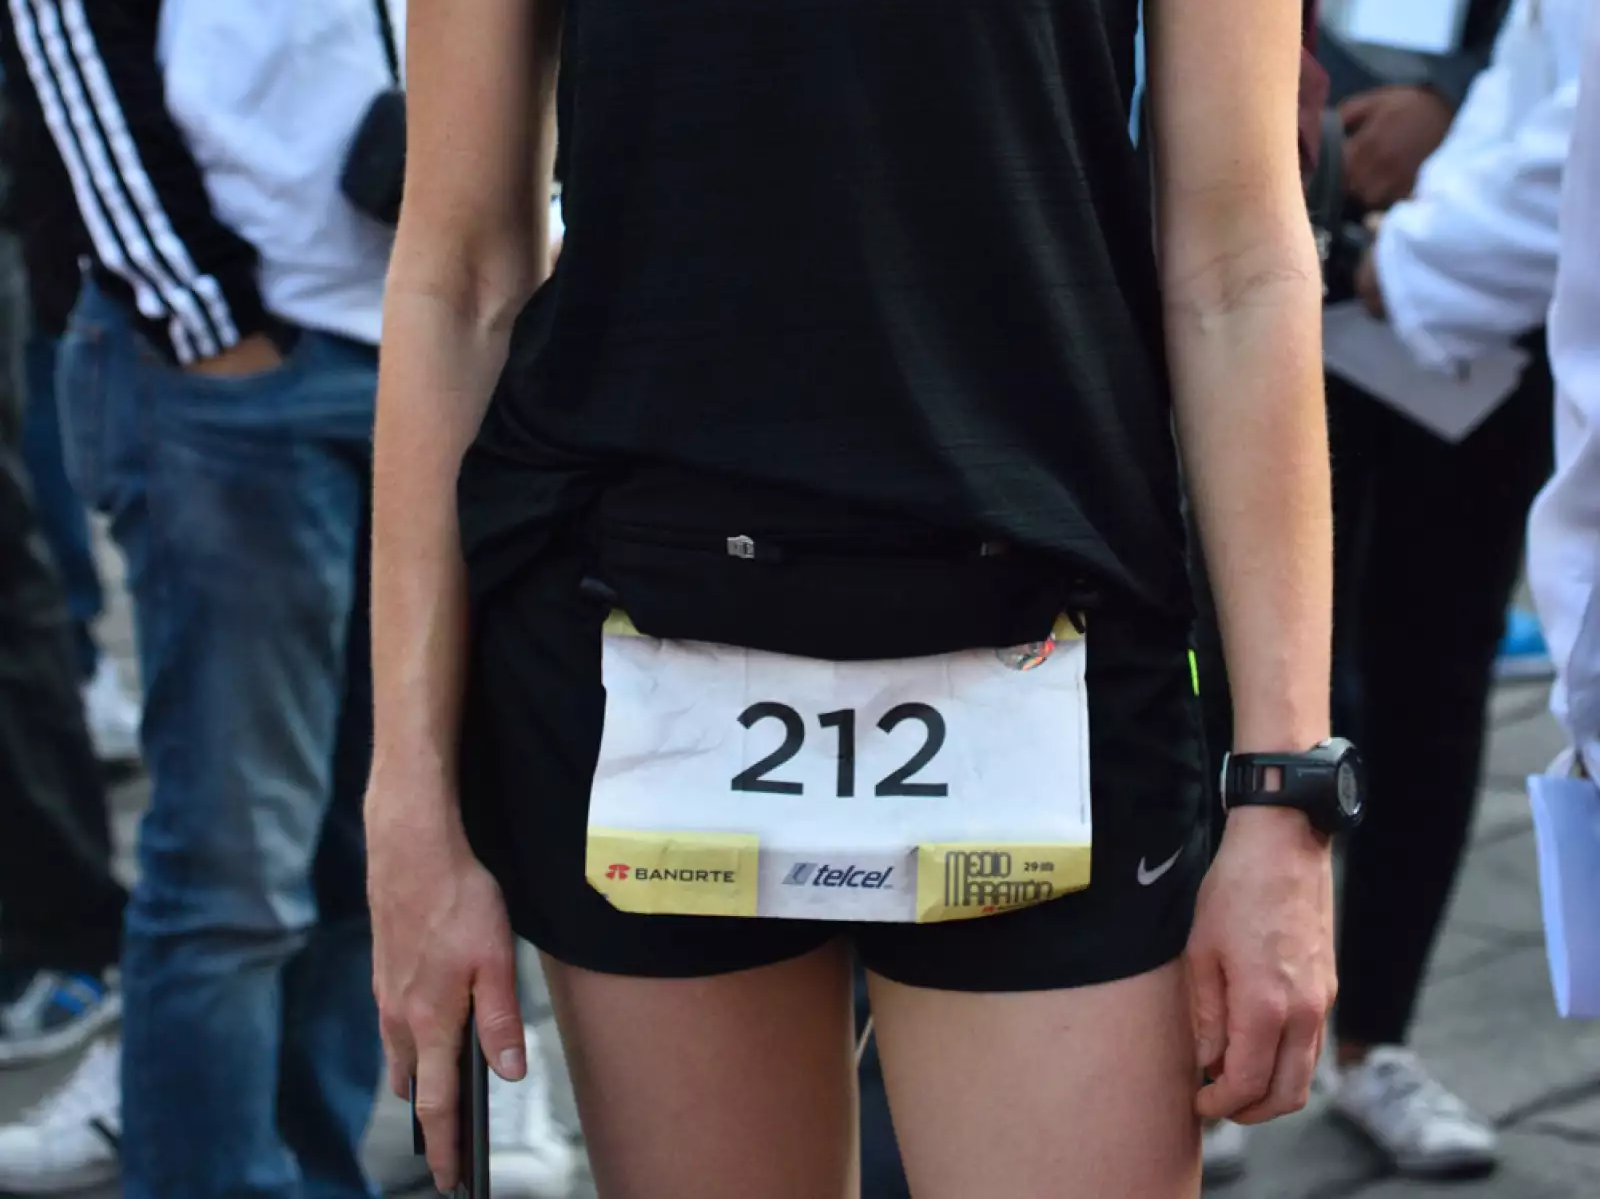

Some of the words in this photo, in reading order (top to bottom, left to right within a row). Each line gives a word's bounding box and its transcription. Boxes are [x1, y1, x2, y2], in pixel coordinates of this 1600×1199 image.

[731, 701, 949, 798] 212
[635, 867, 735, 884] BANORTE
[811, 864, 893, 889] telcel
